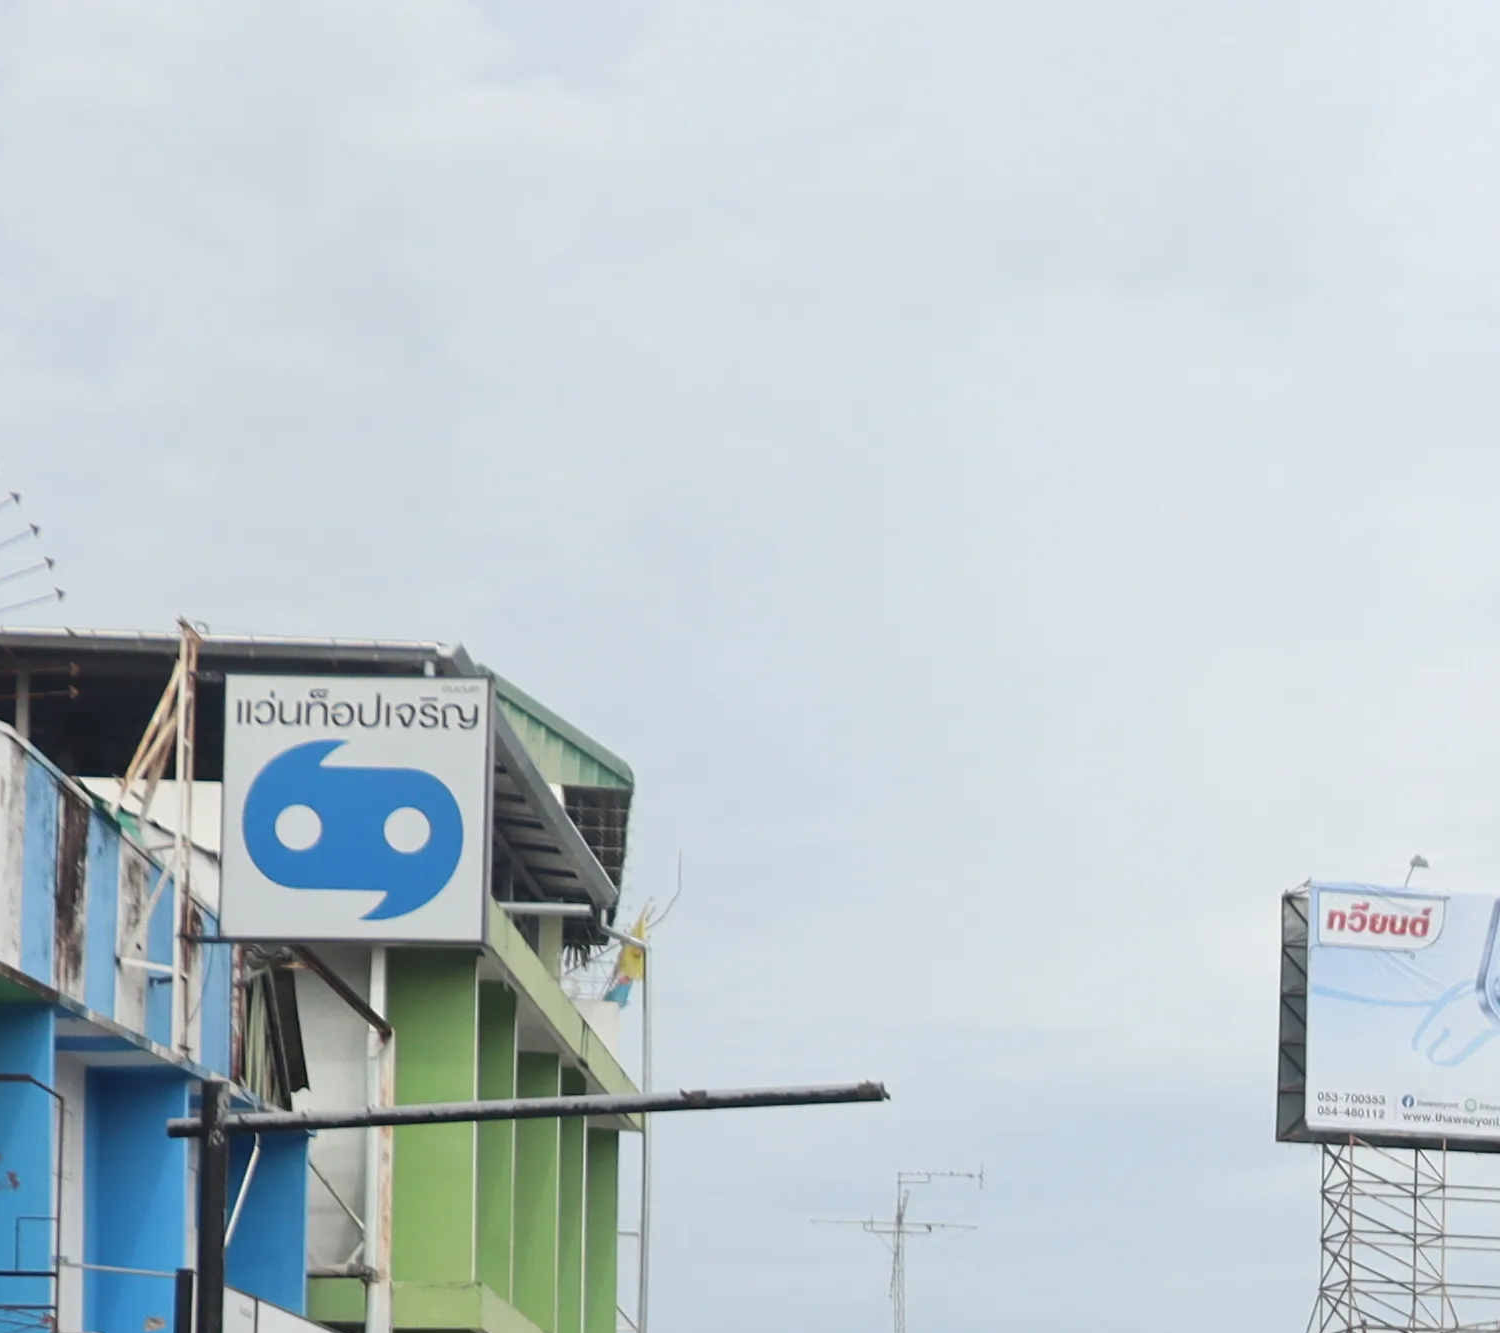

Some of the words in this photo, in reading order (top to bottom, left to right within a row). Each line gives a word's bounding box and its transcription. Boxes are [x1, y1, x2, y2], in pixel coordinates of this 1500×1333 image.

[237, 688, 479, 730] แว่นท็อปเจริญ
[1327, 902, 1432, 938] ทวียนต์
[1317, 1091, 1386, 1106] 053-700353
